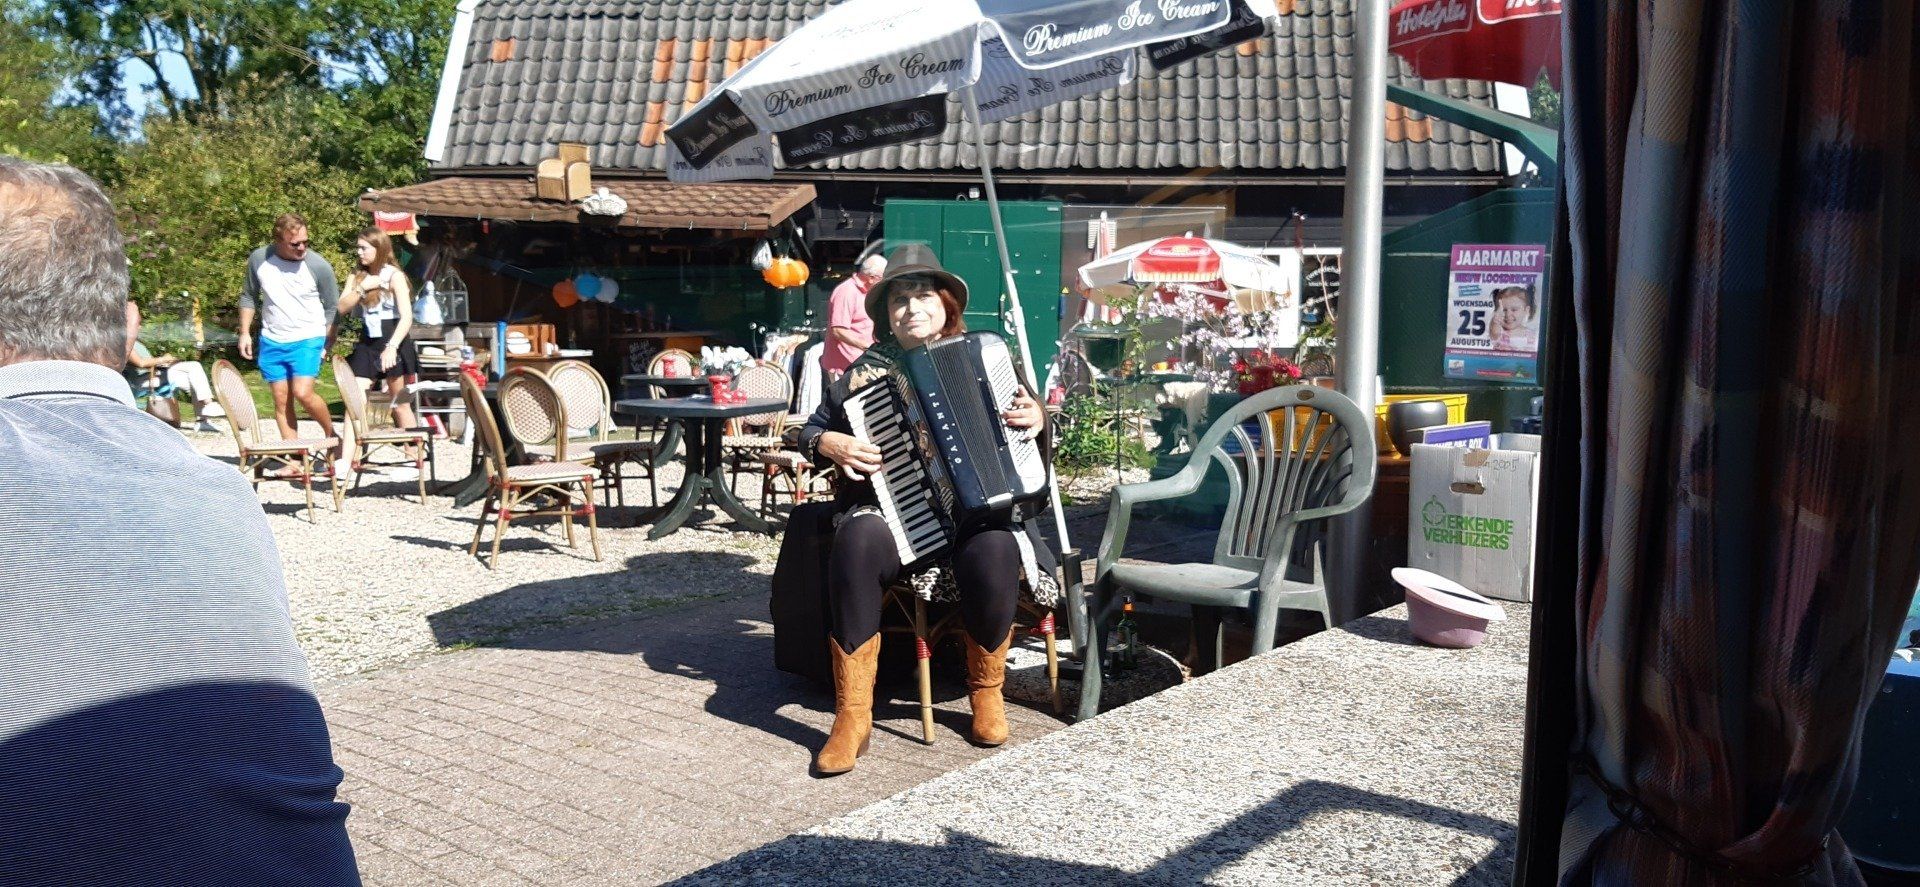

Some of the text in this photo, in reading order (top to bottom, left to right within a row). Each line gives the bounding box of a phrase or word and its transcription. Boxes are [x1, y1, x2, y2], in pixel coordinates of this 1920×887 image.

[1023, 19, 1113, 56] Premium
[1118, 0, 1155, 30] Ice
[1157, 0, 1220, 21] Cream
[764, 52, 965, 117] Premium Ice Cream
[1456, 250, 1539, 267] JAARMARKT
[1453, 300, 1493, 308] WOENSDAG
[1457, 310, 1486, 336] 25
[1450, 337, 1491, 347] AUGUSTUS
[1446, 513, 1514, 535] ERKENDE
[1423, 526, 1509, 550] VERHUIZERS
